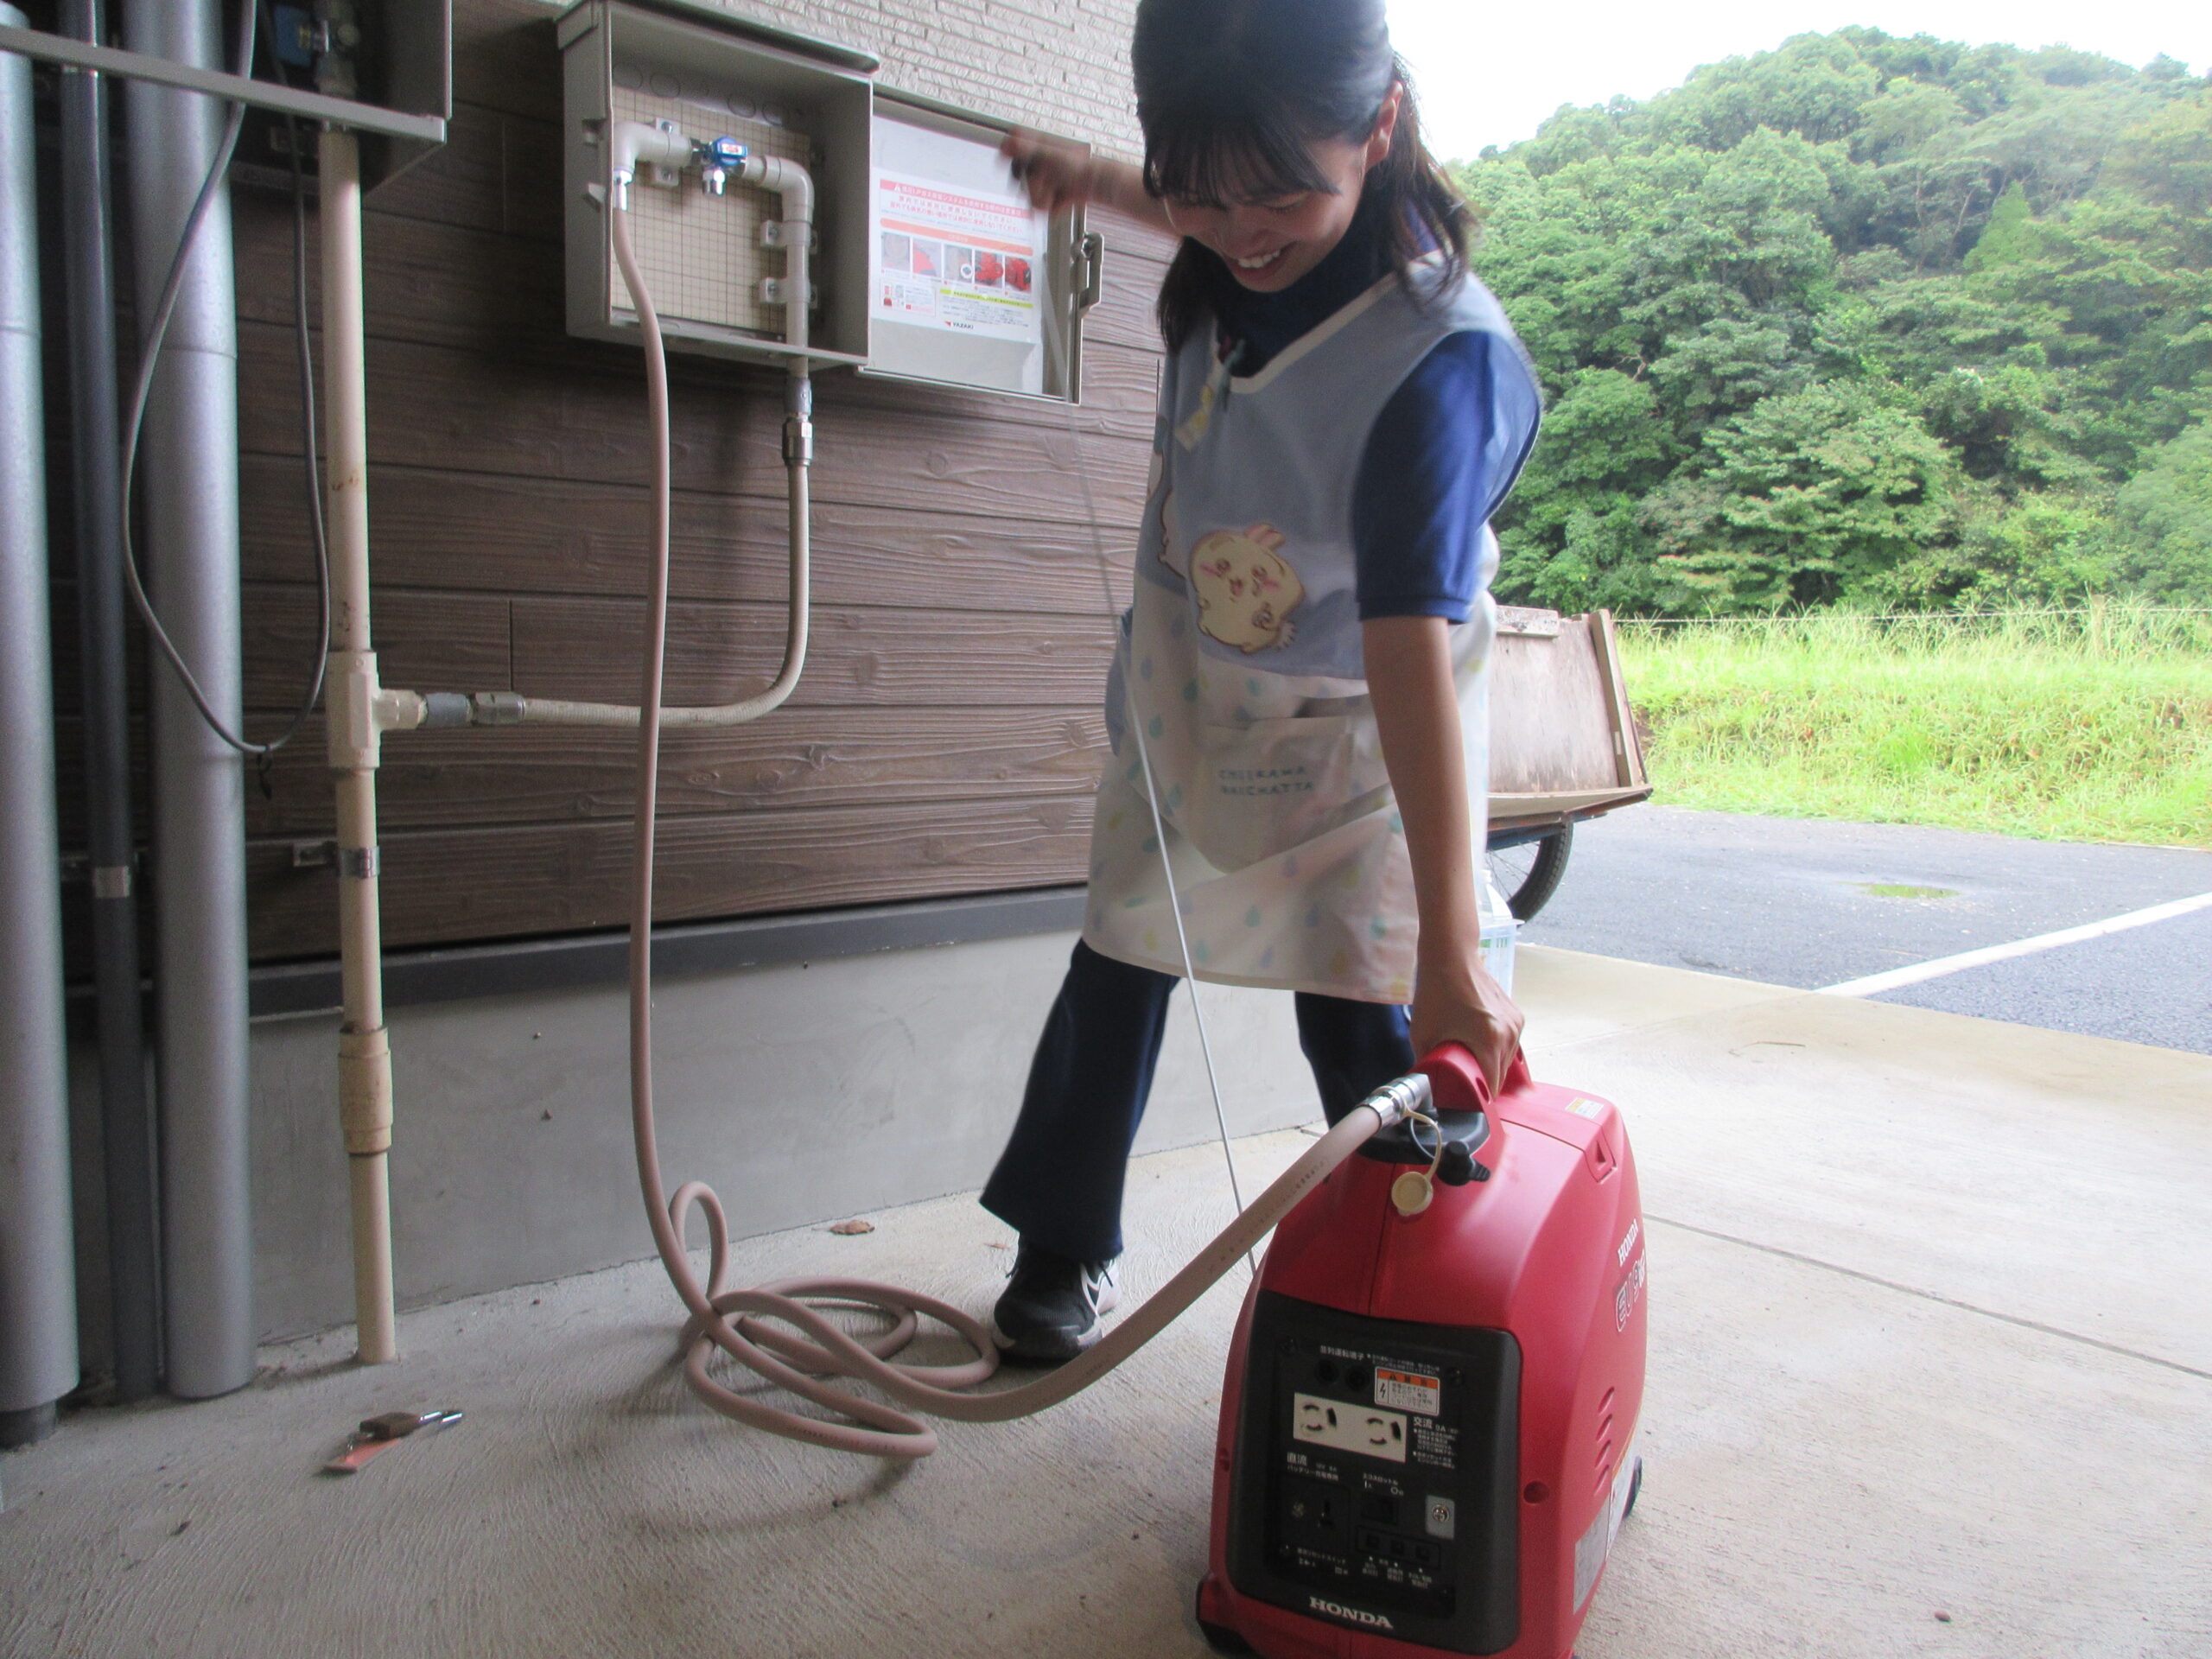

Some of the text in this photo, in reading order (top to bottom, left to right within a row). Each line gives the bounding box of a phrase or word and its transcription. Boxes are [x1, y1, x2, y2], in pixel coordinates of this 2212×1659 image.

[1618, 1218, 1639, 1267] HONDA
[1413, 1417, 1433, 1429] 交流
[1287, 1452, 1307, 1466] 直流
[1309, 1596, 1394, 1629] HONDA
